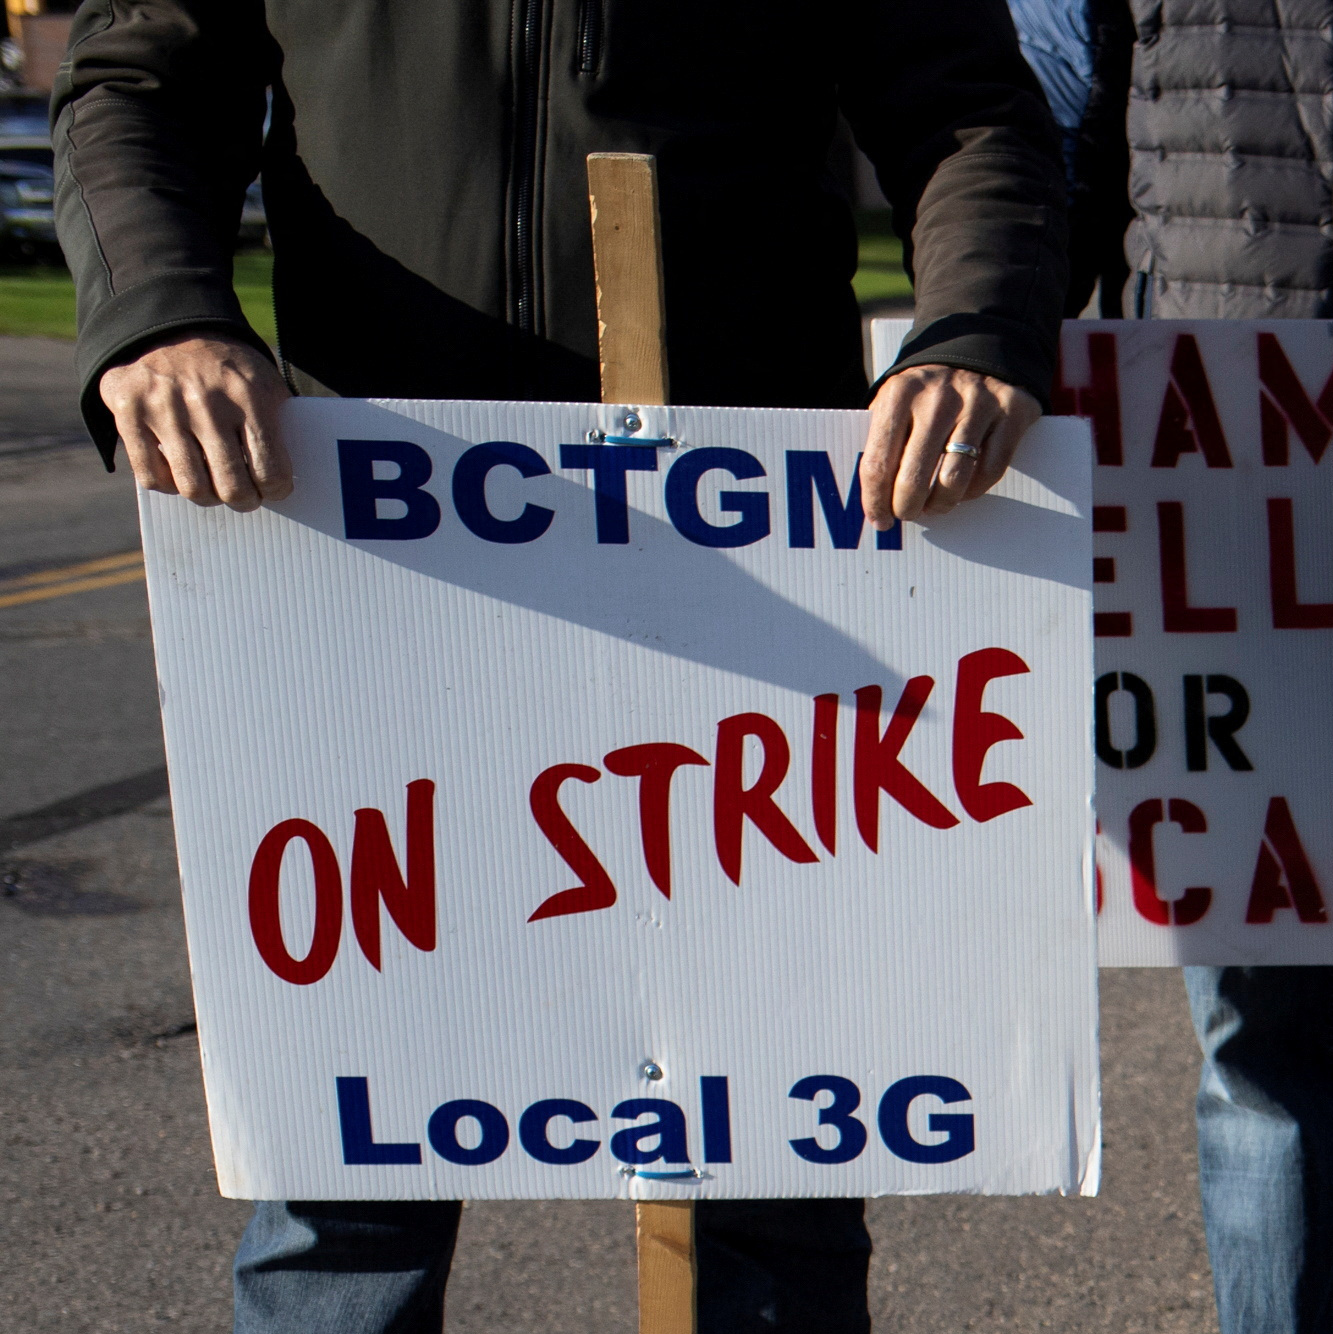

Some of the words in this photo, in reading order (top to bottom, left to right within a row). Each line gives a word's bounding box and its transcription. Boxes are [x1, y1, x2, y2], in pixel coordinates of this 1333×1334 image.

[337, 438, 904, 551] BCTGM
[1095, 671, 1255, 773] OR
[248, 778, 437, 986] ON
[527, 646, 1033, 922] STRIKE
[335, 1074, 732, 1166] Local
[789, 1073, 976, 1165] 3G
